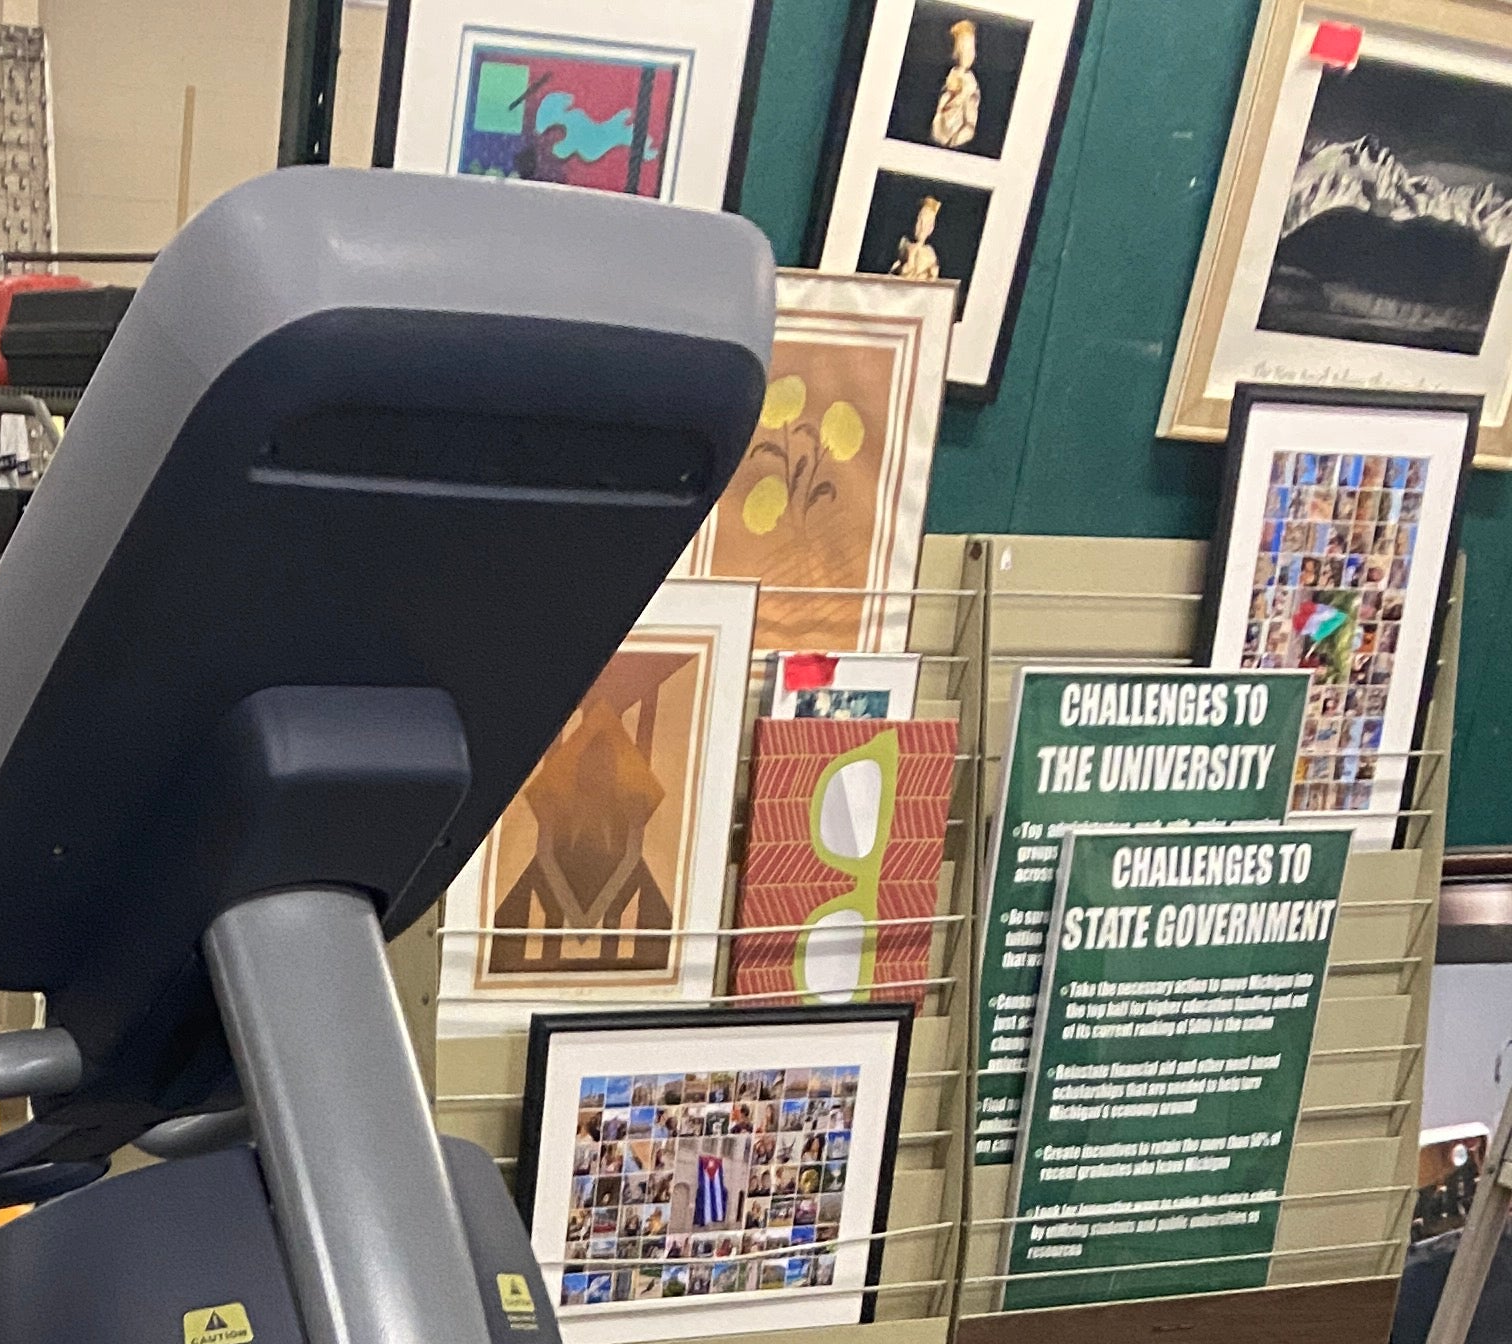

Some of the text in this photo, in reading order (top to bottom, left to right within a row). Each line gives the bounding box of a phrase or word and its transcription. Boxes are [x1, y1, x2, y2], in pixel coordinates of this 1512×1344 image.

[1059, 682, 1269, 727] CHALLENGES TO
[1036, 744, 1277, 794] THE UNIVERSITY
[1111, 842, 1313, 890] CHALLENGES TO
[1061, 899, 1337, 951] STATE GOVERNMENT
[1070, 981, 1097, 998] Take
[1097, 980, 1117, 996] the
[1117, 980, 1174, 997] necessary
[1066, 1002, 1086, 1019] the
[1062, 1023, 1076, 1040] of
[1091, 1022, 1134, 1038] current
[1134, 1020, 1176, 1037] ranking
[1052, 1084, 1125, 1100] scholarships
[1125, 1082, 1148, 1098] that
[1043, 1144, 1081, 1161] Create
[1081, 1142, 1138, 1160] incentives
[191, 1330, 247, 1344] CAUTION
